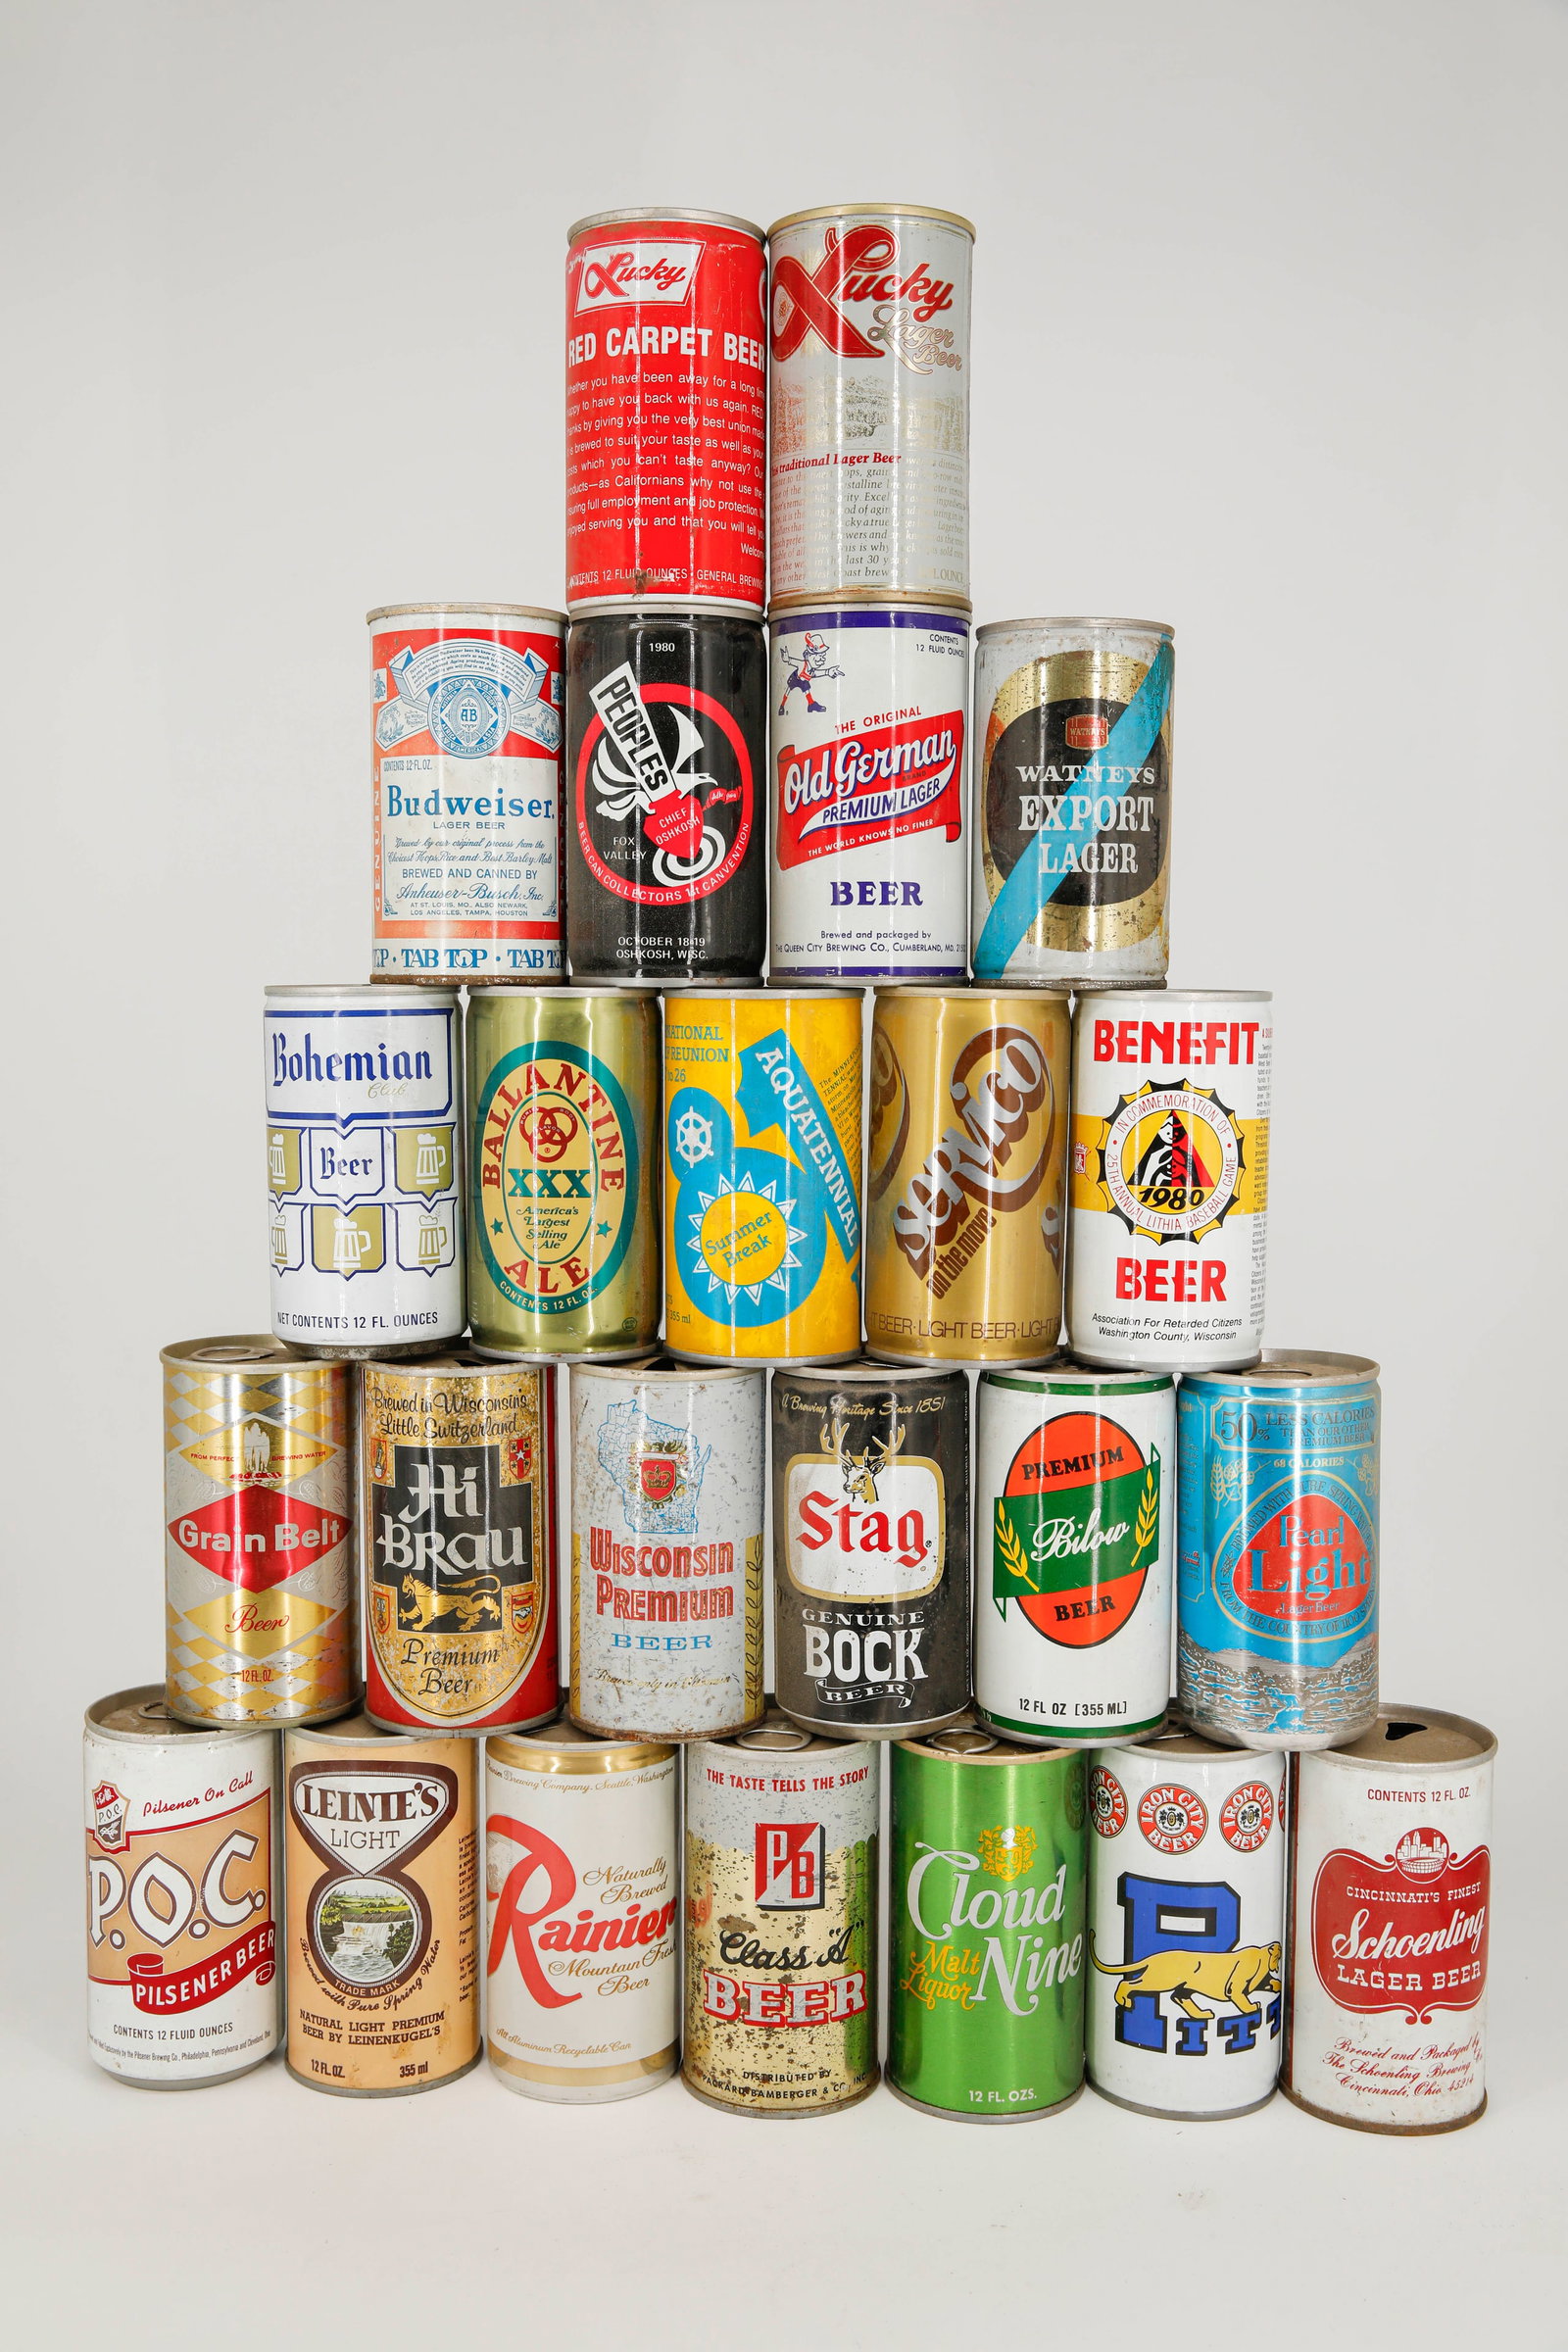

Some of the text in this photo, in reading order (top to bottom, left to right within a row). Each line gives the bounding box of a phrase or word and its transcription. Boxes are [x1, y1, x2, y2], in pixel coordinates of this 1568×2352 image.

[585, 252, 685, 298] Lucky
[772, 225, 954, 362] Lucky
[569, 326, 764, 372] RED CARPET BEER
[867, 305, 954, 374] Lager
[913, 344, 961, 370] Beer
[643, 372, 709, 387] been away
[645, 393, 672, 403] back
[703, 417, 725, 428] best
[672, 435, 701, 446] taste
[711, 459, 751, 476] anyway?
[780, 454, 830, 472] traditional
[873, 453, 902, 464] Beer
[615, 475, 684, 486] Californians
[603, 497, 669, 508] employment
[589, 518, 622, 530] serving
[649, 643, 675, 652] 1980
[461, 709, 477, 721] AB
[835, 706, 921, 734] THE ORIGINAL
[597, 675, 668, 792] PEOPLES
[784, 729, 956, 814] Old German
[1015, 765, 1155, 784] WATNEYS
[823, 778, 940, 823] PREMIUM LAGER
[1018, 795, 1153, 831] EXPORT
[656, 816, 700, 845] OSHKOSH
[659, 808, 687, 828] CHIEF
[859, 819, 933, 843] KNOWS FINER
[613, 837, 635, 846] FOX
[604, 823, 750, 902] COLLECTORS CANVENTION
[1040, 843, 1138, 873] LAGER
[403, 869, 521, 879] BREWED CANNED
[830, 882, 923, 906] BEER
[618, 937, 672, 946] OCTOBER
[876, 931, 918, 940] packaged
[402, 949, 544, 968] TAB TOP TAB
[616, 951, 674, 960] OSHKOSH,
[1094, 1020, 1258, 1064] BENEFIT
[272, 1033, 432, 1086] Bohemian
[368, 1083, 408, 1099] Club
[1126, 1095, 1219, 1122] COMMEMORATION
[483, 1063, 625, 1192] BALLANTINE
[755, 1047, 858, 1248] AQUATENNIAL
[320, 1147, 372, 1179] Beer
[508, 1168, 591, 1198] XXX
[516, 1206, 578, 1215] America's
[1139, 1188, 1204, 1210] 1980
[1147, 1190, 1228, 1231] LITHIA BASEBALL
[523, 1217, 570, 1227] Largest
[526, 1229, 567, 1241] Selling
[706, 1212, 772, 1255] Summer
[722, 1233, 772, 1268] Break
[505, 1256, 590, 1294] ALE
[1116, 1257, 1227, 1302] BEER
[292, 1312, 437, 1329] CONTENTS OUNCES
[1092, 1313, 1242, 1328] Association Retarded Citizens
[1099, 1327, 1237, 1341] Washington Wisconsin
[371, 1387, 417, 1412] Brewed
[791, 1396, 946, 1420] Brewing Heritage Since 1851
[380, 1414, 517, 1444] Little Switzerland
[1266, 1406, 1375, 1426] LESS CALORIES
[1022, 1446, 1124, 1480] PREMIUM
[398, 1463, 483, 1523] Hi
[179, 1519, 340, 1552] Grain Belt
[796, 1491, 928, 1568] Stag
[1031, 1507, 1129, 1561] Bilow
[1280, 1515, 1345, 1547] Pearl
[1248, 1548, 1372, 1600] Light
[224, 1603, 289, 1633] Beer
[802, 1609, 924, 1626] GENUINE
[1054, 1595, 1115, 1621] BEER
[401, 1638, 499, 1666] Premium
[612, 1633, 712, 1650] BEER
[803, 1625, 928, 1683] BOCK
[418, 1667, 472, 1695] Beer
[825, 1684, 906, 1701] BEER
[707, 1766, 868, 1791] THE TASTE TELLS THE STORY
[143, 1771, 253, 1817] Pilsener Call
[302, 1782, 439, 1823] LEINIE'S
[1368, 1789, 1426, 1802] CONTENTS
[1141, 1788, 1203, 1830] IRON CITY
[331, 1829, 400, 1849] LIGHT
[1148, 1831, 1199, 1851] BEER
[582, 1857, 666, 1886] Naturally
[89, 1830, 267, 1949] P.O.C.
[601, 1875, 667, 1905] Brewed
[907, 1842, 1066, 1940] Cloud
[1347, 1882, 1481, 1903] CINCINNATI'S FINEST
[486, 1814, 677, 2009] Rainier
[1332, 1906, 1485, 1960] Schoenling
[548, 1938, 676, 1977] Mountain Fresh
[719, 1930, 812, 1970] Class
[909, 1941, 980, 1981] Malt
[136, 1929, 273, 2006] PILSENER BEER
[969, 1934, 1083, 2016] Nine
[1337, 1961, 1481, 1990] LAGER BEER
[334, 1980, 401, 1996] TRADE MARK
[598, 1976, 649, 1996] Beer
[704, 1969, 868, 2028] BEER
[900, 1965, 975, 2010] Liquor
[114, 2025, 195, 2040] CONTENTS FLUID
[300, 2009, 445, 2032] NATURAL LIGHT PREMIUM
[349, 2026, 440, 2045] LEINENKUGEL'S
[554, 2044, 608, 2058] Recyclable
[1350, 2058, 1421, 2083] Schoenling
[1336, 2073, 1410, 2097] Cincinnati,
